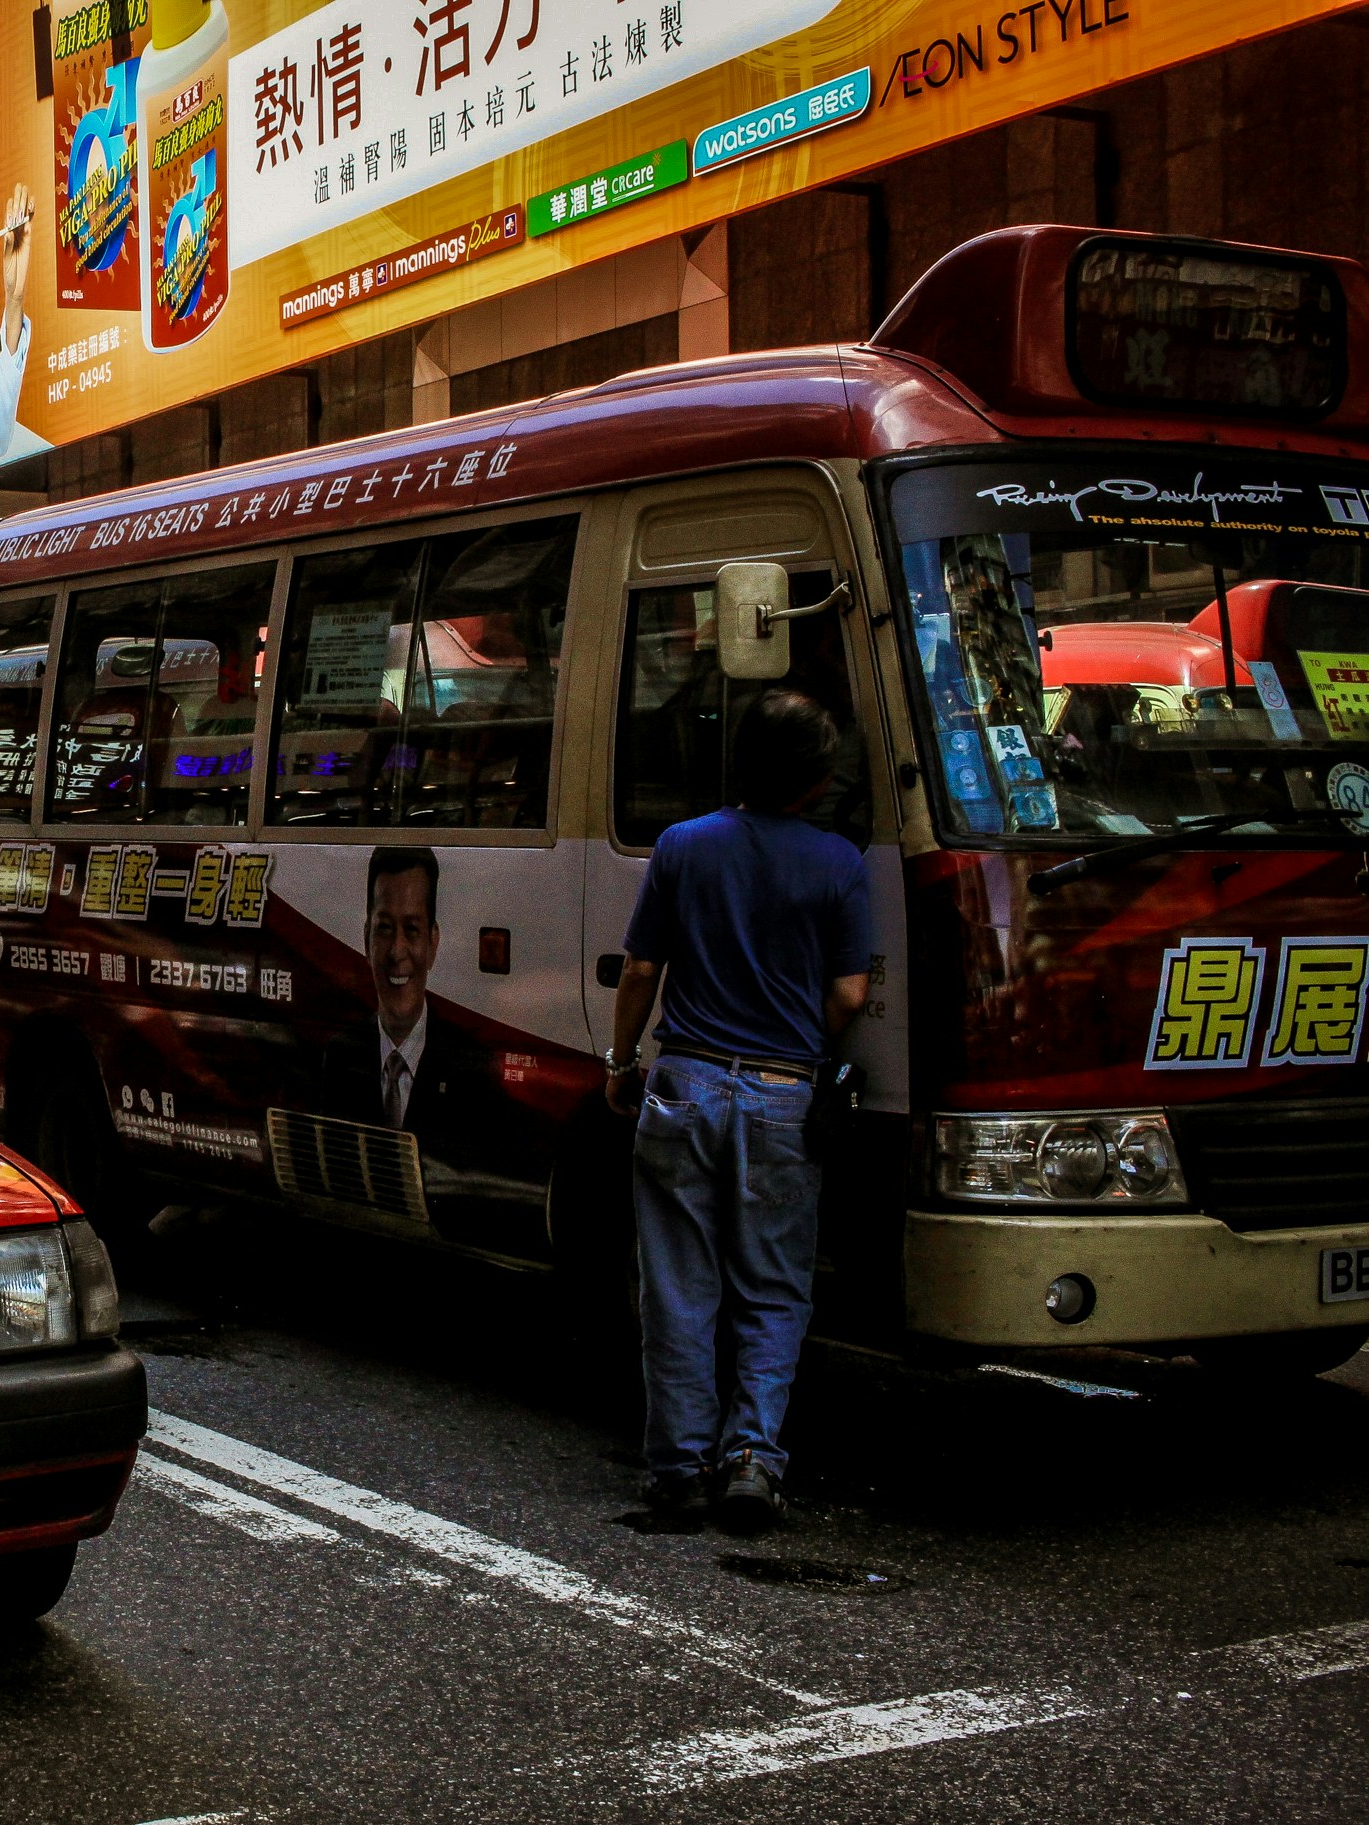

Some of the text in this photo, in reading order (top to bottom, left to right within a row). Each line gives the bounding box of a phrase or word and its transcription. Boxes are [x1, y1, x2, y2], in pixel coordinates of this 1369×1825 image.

[998, 0, 1129, 64] STYLE
[314, 130, 407, 205] 溫補腎陽
[429, 72, 536, 156] 固本培元
[706, 83, 855, 157] watsons 屈臣氏
[119, 138, 138, 180] PIL
[550, 176, 609, 224] 華潤堂
[282, 281, 344, 320] mannings
[348, 268, 374, 299] 萬寧
[395, 234, 466, 278] mannings
[49, 379, 69, 404] HKP
[80, 361, 112, 392] 04945
[35, 525, 86, 558] LIGHT
[90, 518, 127, 550] BUS
[129, 515, 149, 543] 16
[147, 502, 210, 540] SEATS
[215, 442, 520, 529] 公共小型巴士十六座位
[1088, 515, 1124, 525] The
[1211, 520, 1282, 533] authority
[1287, 525, 1308, 534] on
[1309, 659, 1321, 667] TO
[10, 946, 47, 971] 2855
[52, 949, 90, 976] 3657
[150, 959, 193, 988] 2337
[261, 968, 293, 1002] 旺角
[1147, 938, 1367, 1069] 鼎展
